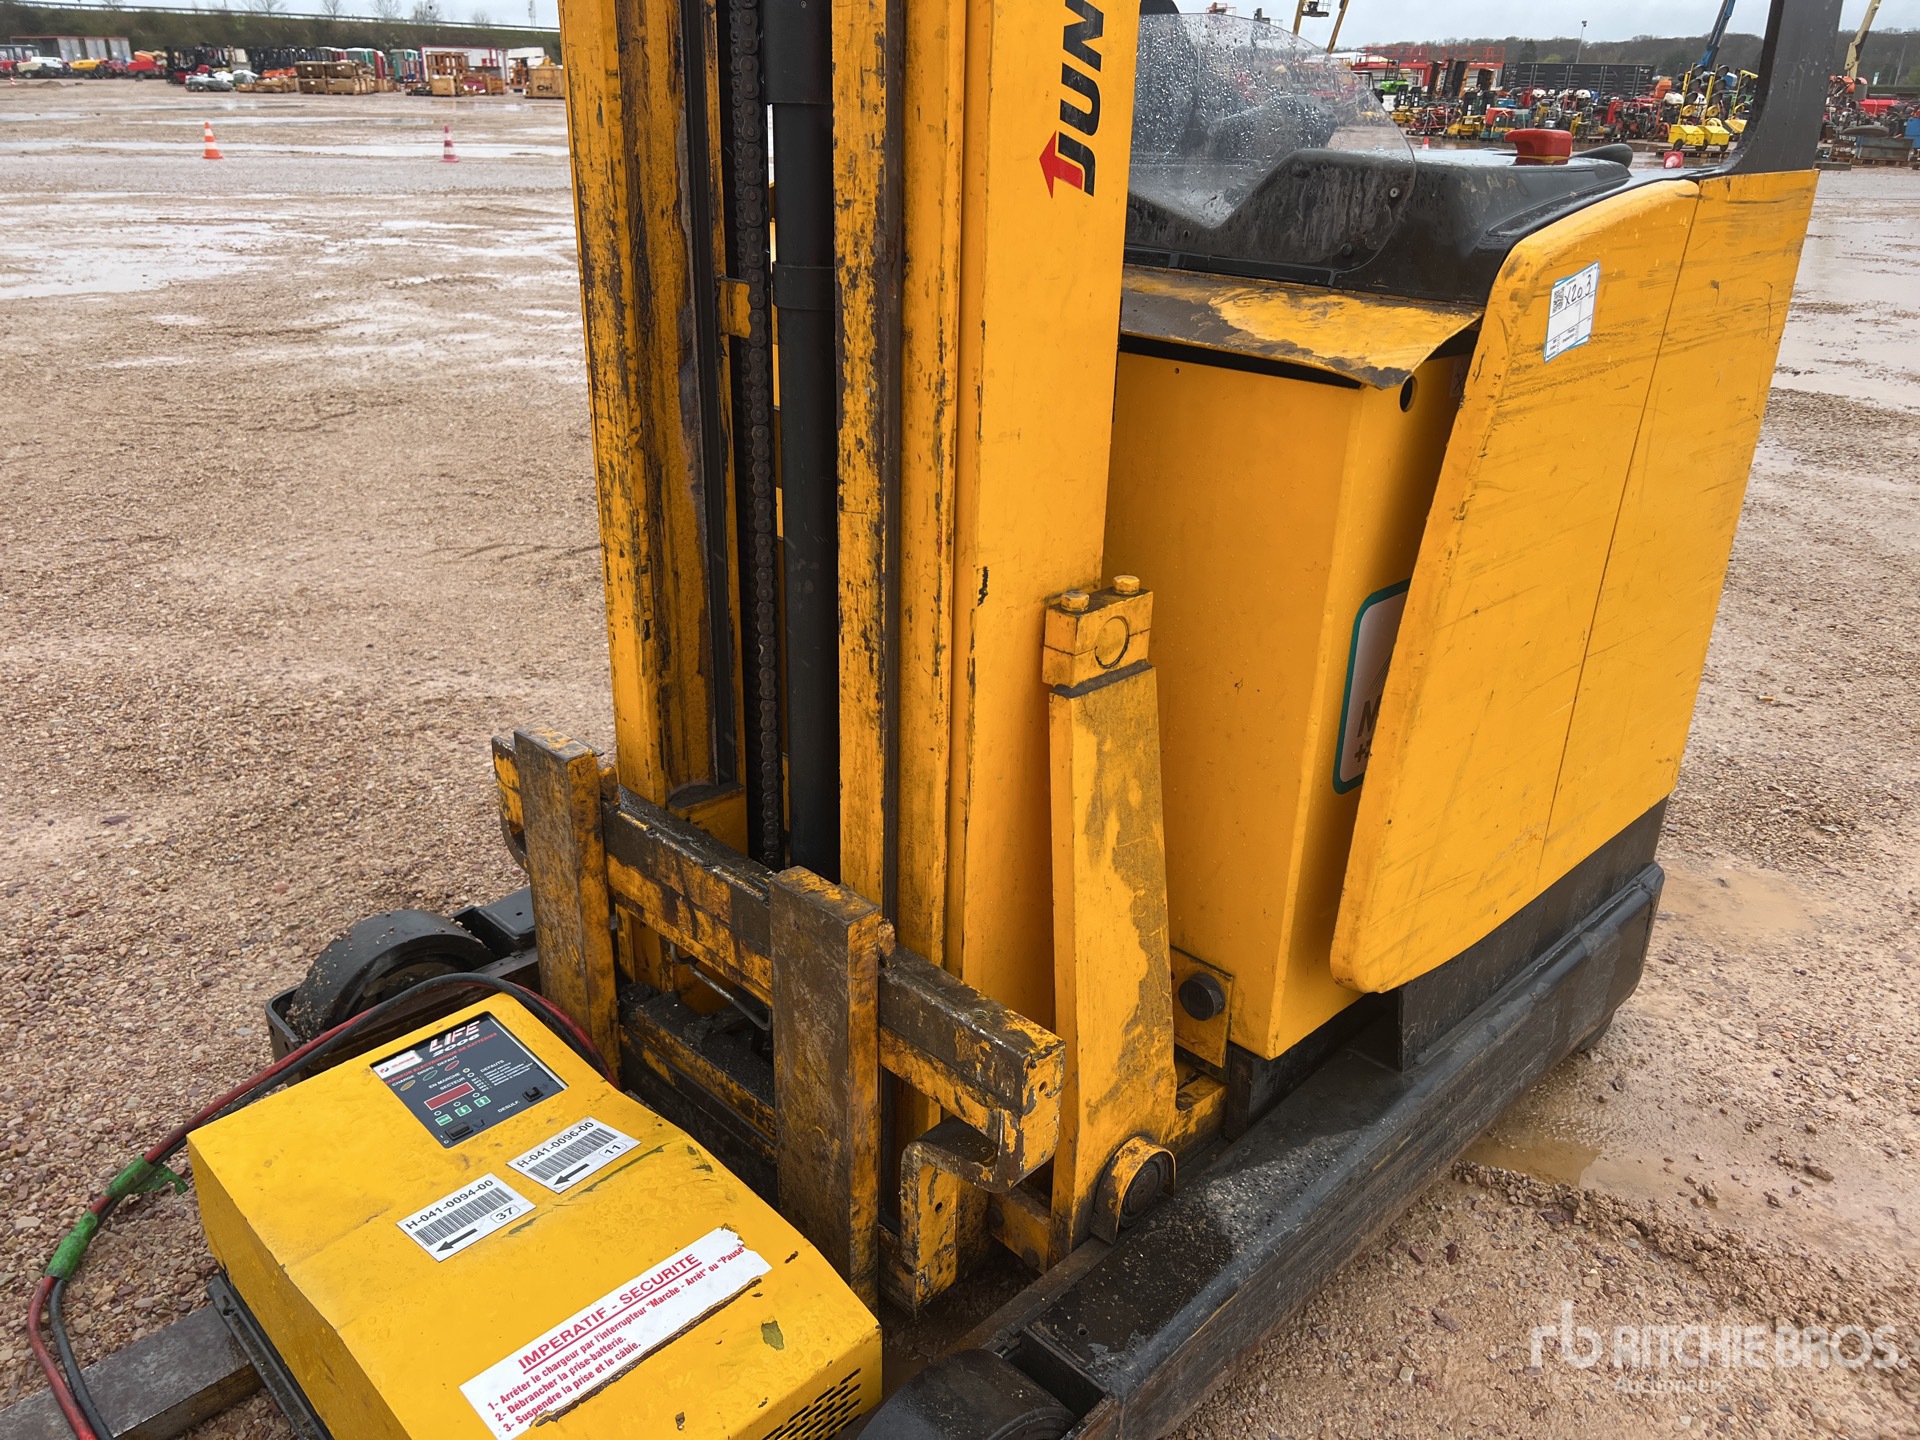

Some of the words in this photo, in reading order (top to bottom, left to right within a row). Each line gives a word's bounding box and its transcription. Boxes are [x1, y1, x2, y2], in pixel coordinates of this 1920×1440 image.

[429, 1020, 480, 1053] LIFE
[436, 1055, 458, 1067] DEFAUT
[440, 1076, 466, 1090] SECTEUR
[517, 1121, 595, 1169] H-041-0096-00
[604, 1144, 622, 1156] 11
[405, 1179, 494, 1230] H-041-0094-00
[495, 1207, 514, 1221] 37
[517, 1306, 607, 1370] IMPERATIF
[619, 1253, 700, 1305] SECURITE
[487, 1401, 499, 1411] 1-
[499, 1380, 531, 1404] Arrêter
[530, 1370, 542, 1384] le
[541, 1348, 579, 1377] chargeur
[579, 1340, 595, 1357] par
[594, 1307, 647, 1344] l'interrupteur
[645, 1286, 681, 1309] "Marche
[708, 1263, 719, 1272] ou
[494, 1411, 507, 1422] 2-
[507, 1378, 558, 1415] Débrancher
[557, 1370, 569, 1382] la
[502, 1422, 515, 1433] 3-
[515, 1391, 563, 1425] Suspendre
[562, 1382, 573, 1394] la
[573, 1371, 595, 1391] prise
[594, 1363, 606, 1375] et
[606, 1357, 616, 1368] le
[614, 1342, 642, 1361] câble.
